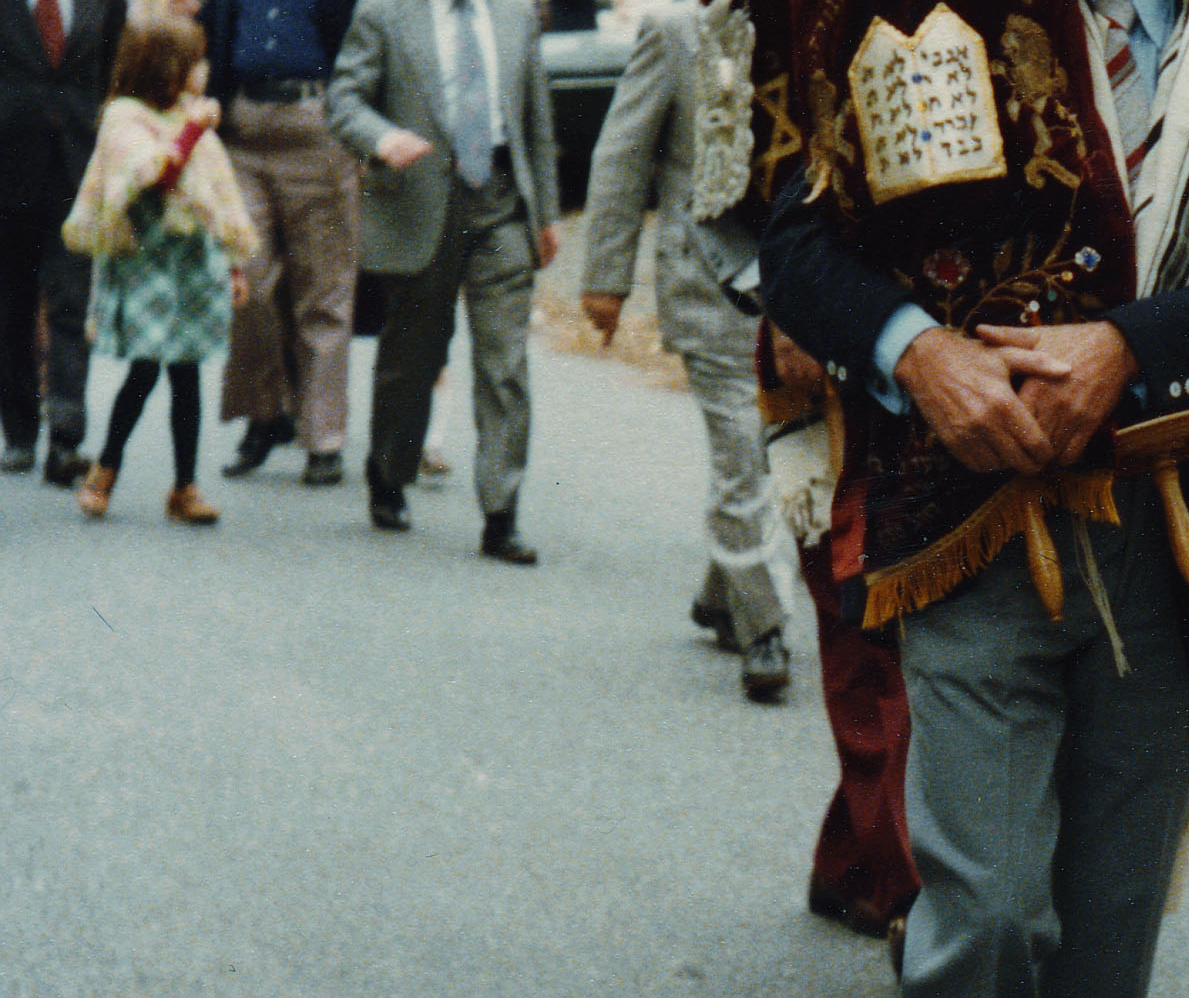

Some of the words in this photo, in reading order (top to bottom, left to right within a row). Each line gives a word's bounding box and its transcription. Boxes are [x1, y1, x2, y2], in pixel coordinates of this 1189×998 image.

[920, 45, 968, 66] אנכי
[947, 62, 972, 84] לא
[951, 85, 976, 108] לא
